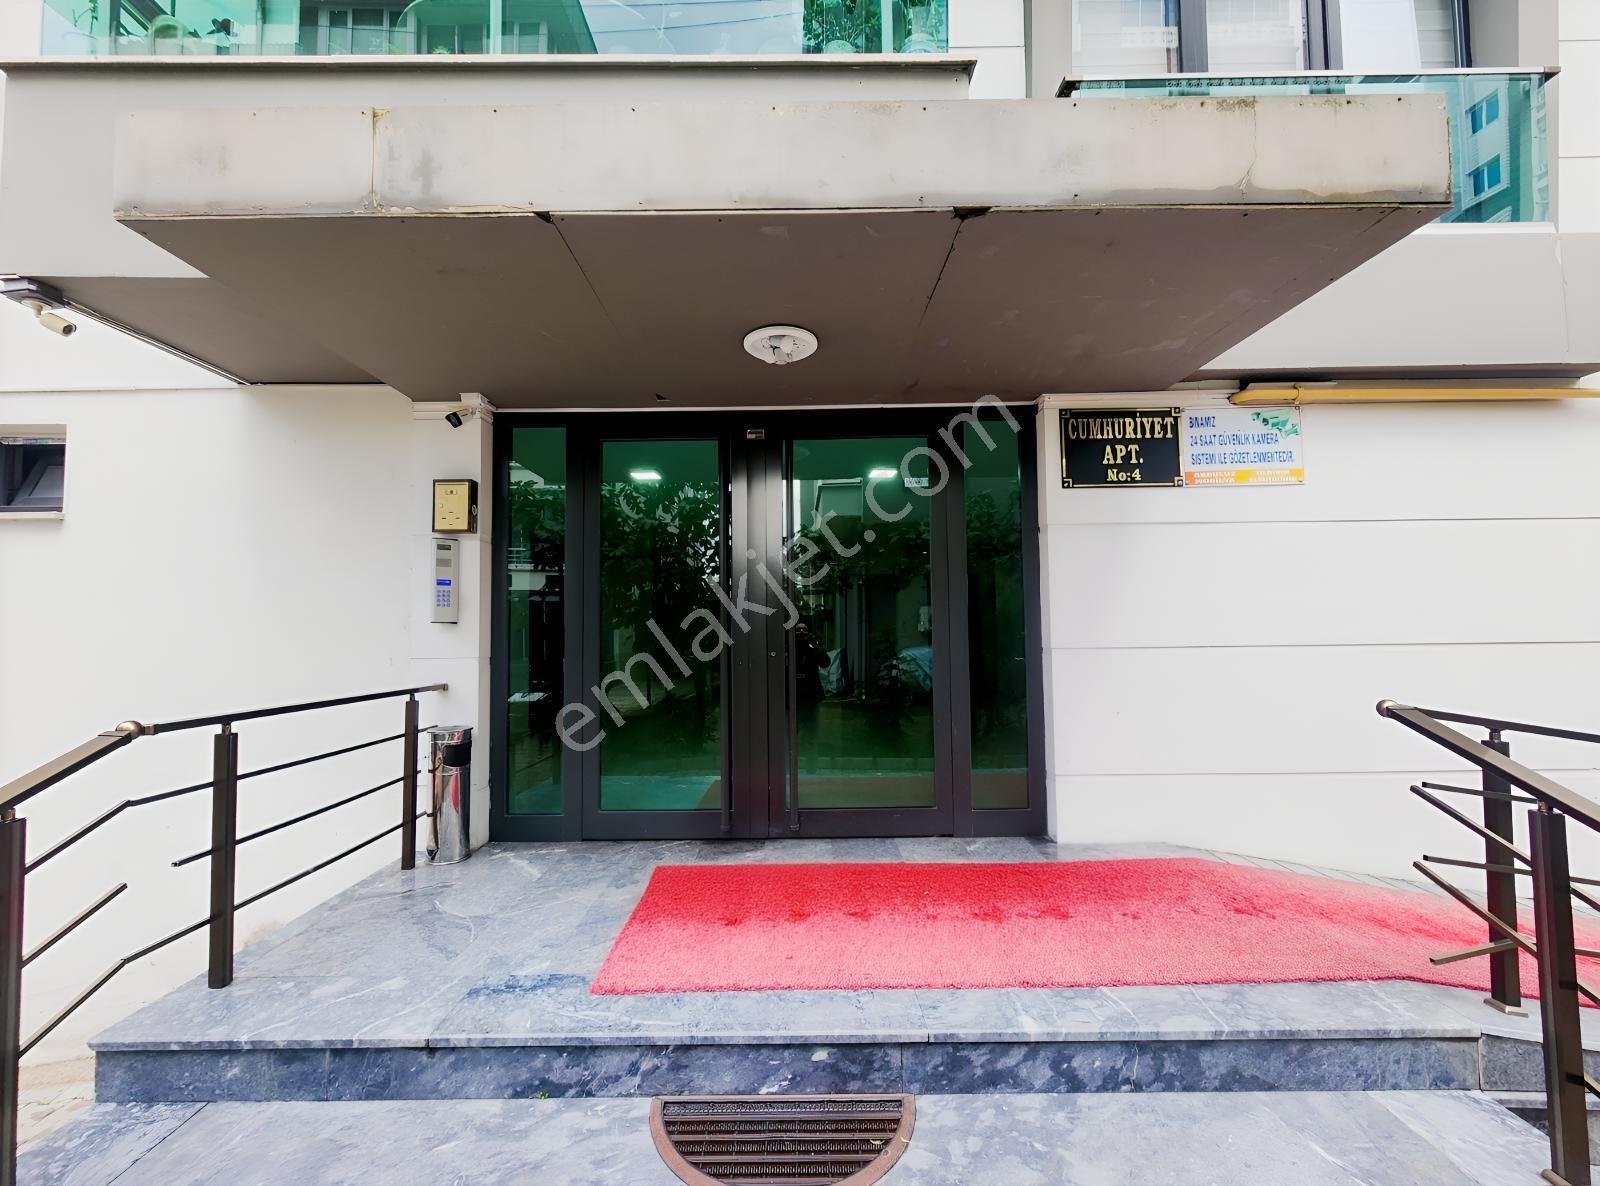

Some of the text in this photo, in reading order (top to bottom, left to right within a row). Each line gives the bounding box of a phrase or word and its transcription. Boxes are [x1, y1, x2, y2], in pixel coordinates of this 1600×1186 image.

[1068, 412, 1175, 440] CUMHURİYET
[1190, 435, 1198, 447] 24
[1199, 434, 1217, 447] SAAT
[1251, 433, 1279, 446] KAMERA
[1102, 444, 1144, 465] APT.
[1106, 468, 1142, 482] No:4
